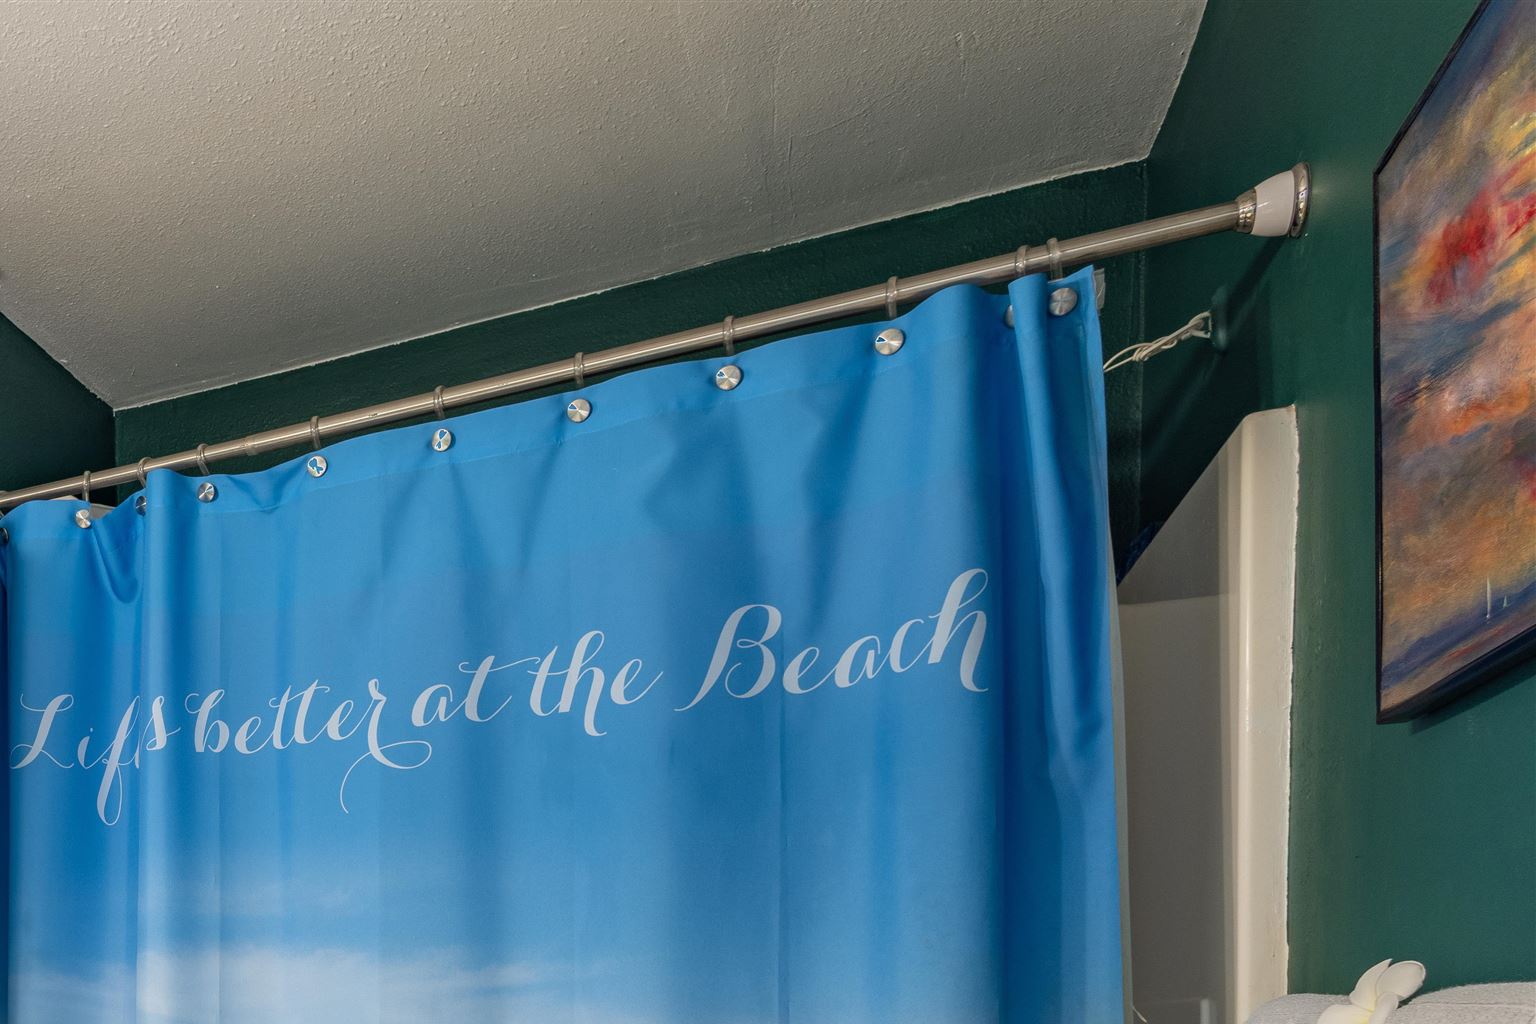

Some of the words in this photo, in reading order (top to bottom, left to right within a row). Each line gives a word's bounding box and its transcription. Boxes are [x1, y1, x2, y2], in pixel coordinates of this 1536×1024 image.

[184, 678, 432, 815] better
[411, 655, 541, 728] at
[527, 630, 664, 737] the
[673, 567, 990, 712] Beach
